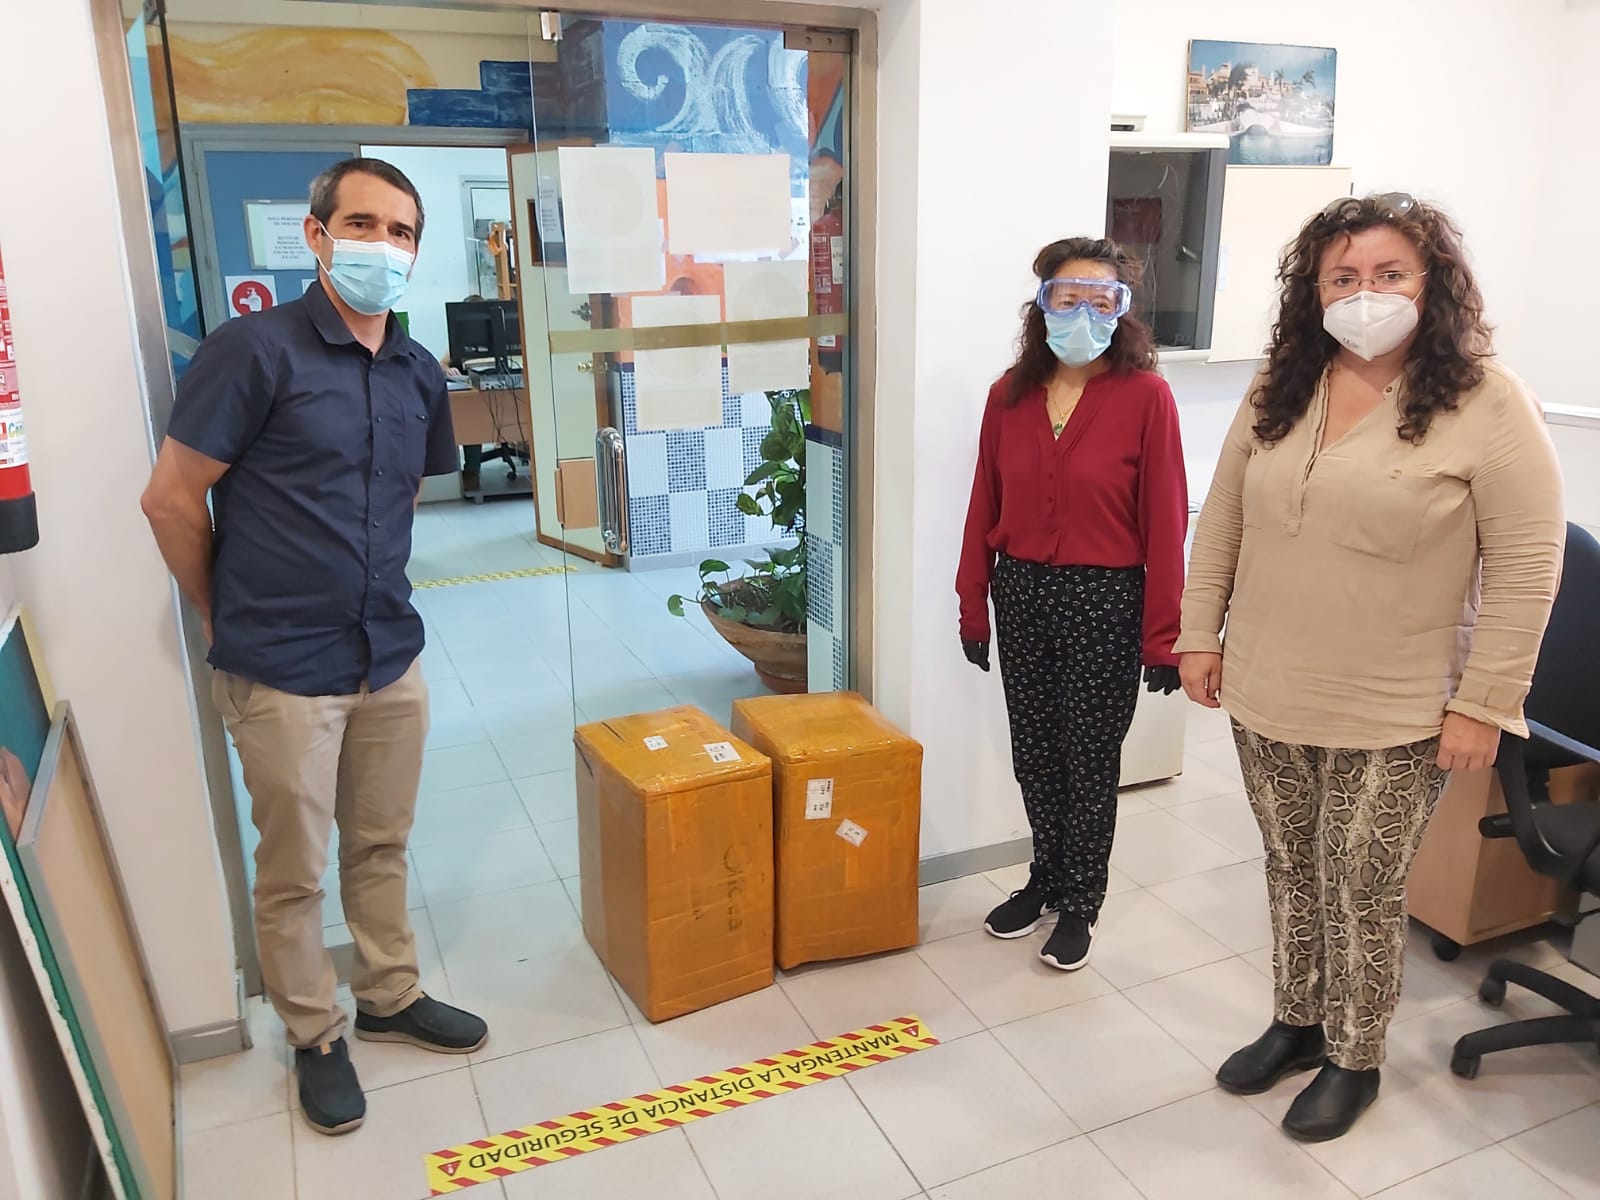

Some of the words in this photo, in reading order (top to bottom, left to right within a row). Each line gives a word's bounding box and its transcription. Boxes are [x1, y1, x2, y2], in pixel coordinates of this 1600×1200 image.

[787, 1032, 900, 1072] MANTENGA
[757, 1067, 786, 1083] LA
[642, 1077, 756, 1120] DISTANCIA
[607, 1112, 638, 1130] DE
[468, 1120, 604, 1169] SEGURIDAD
